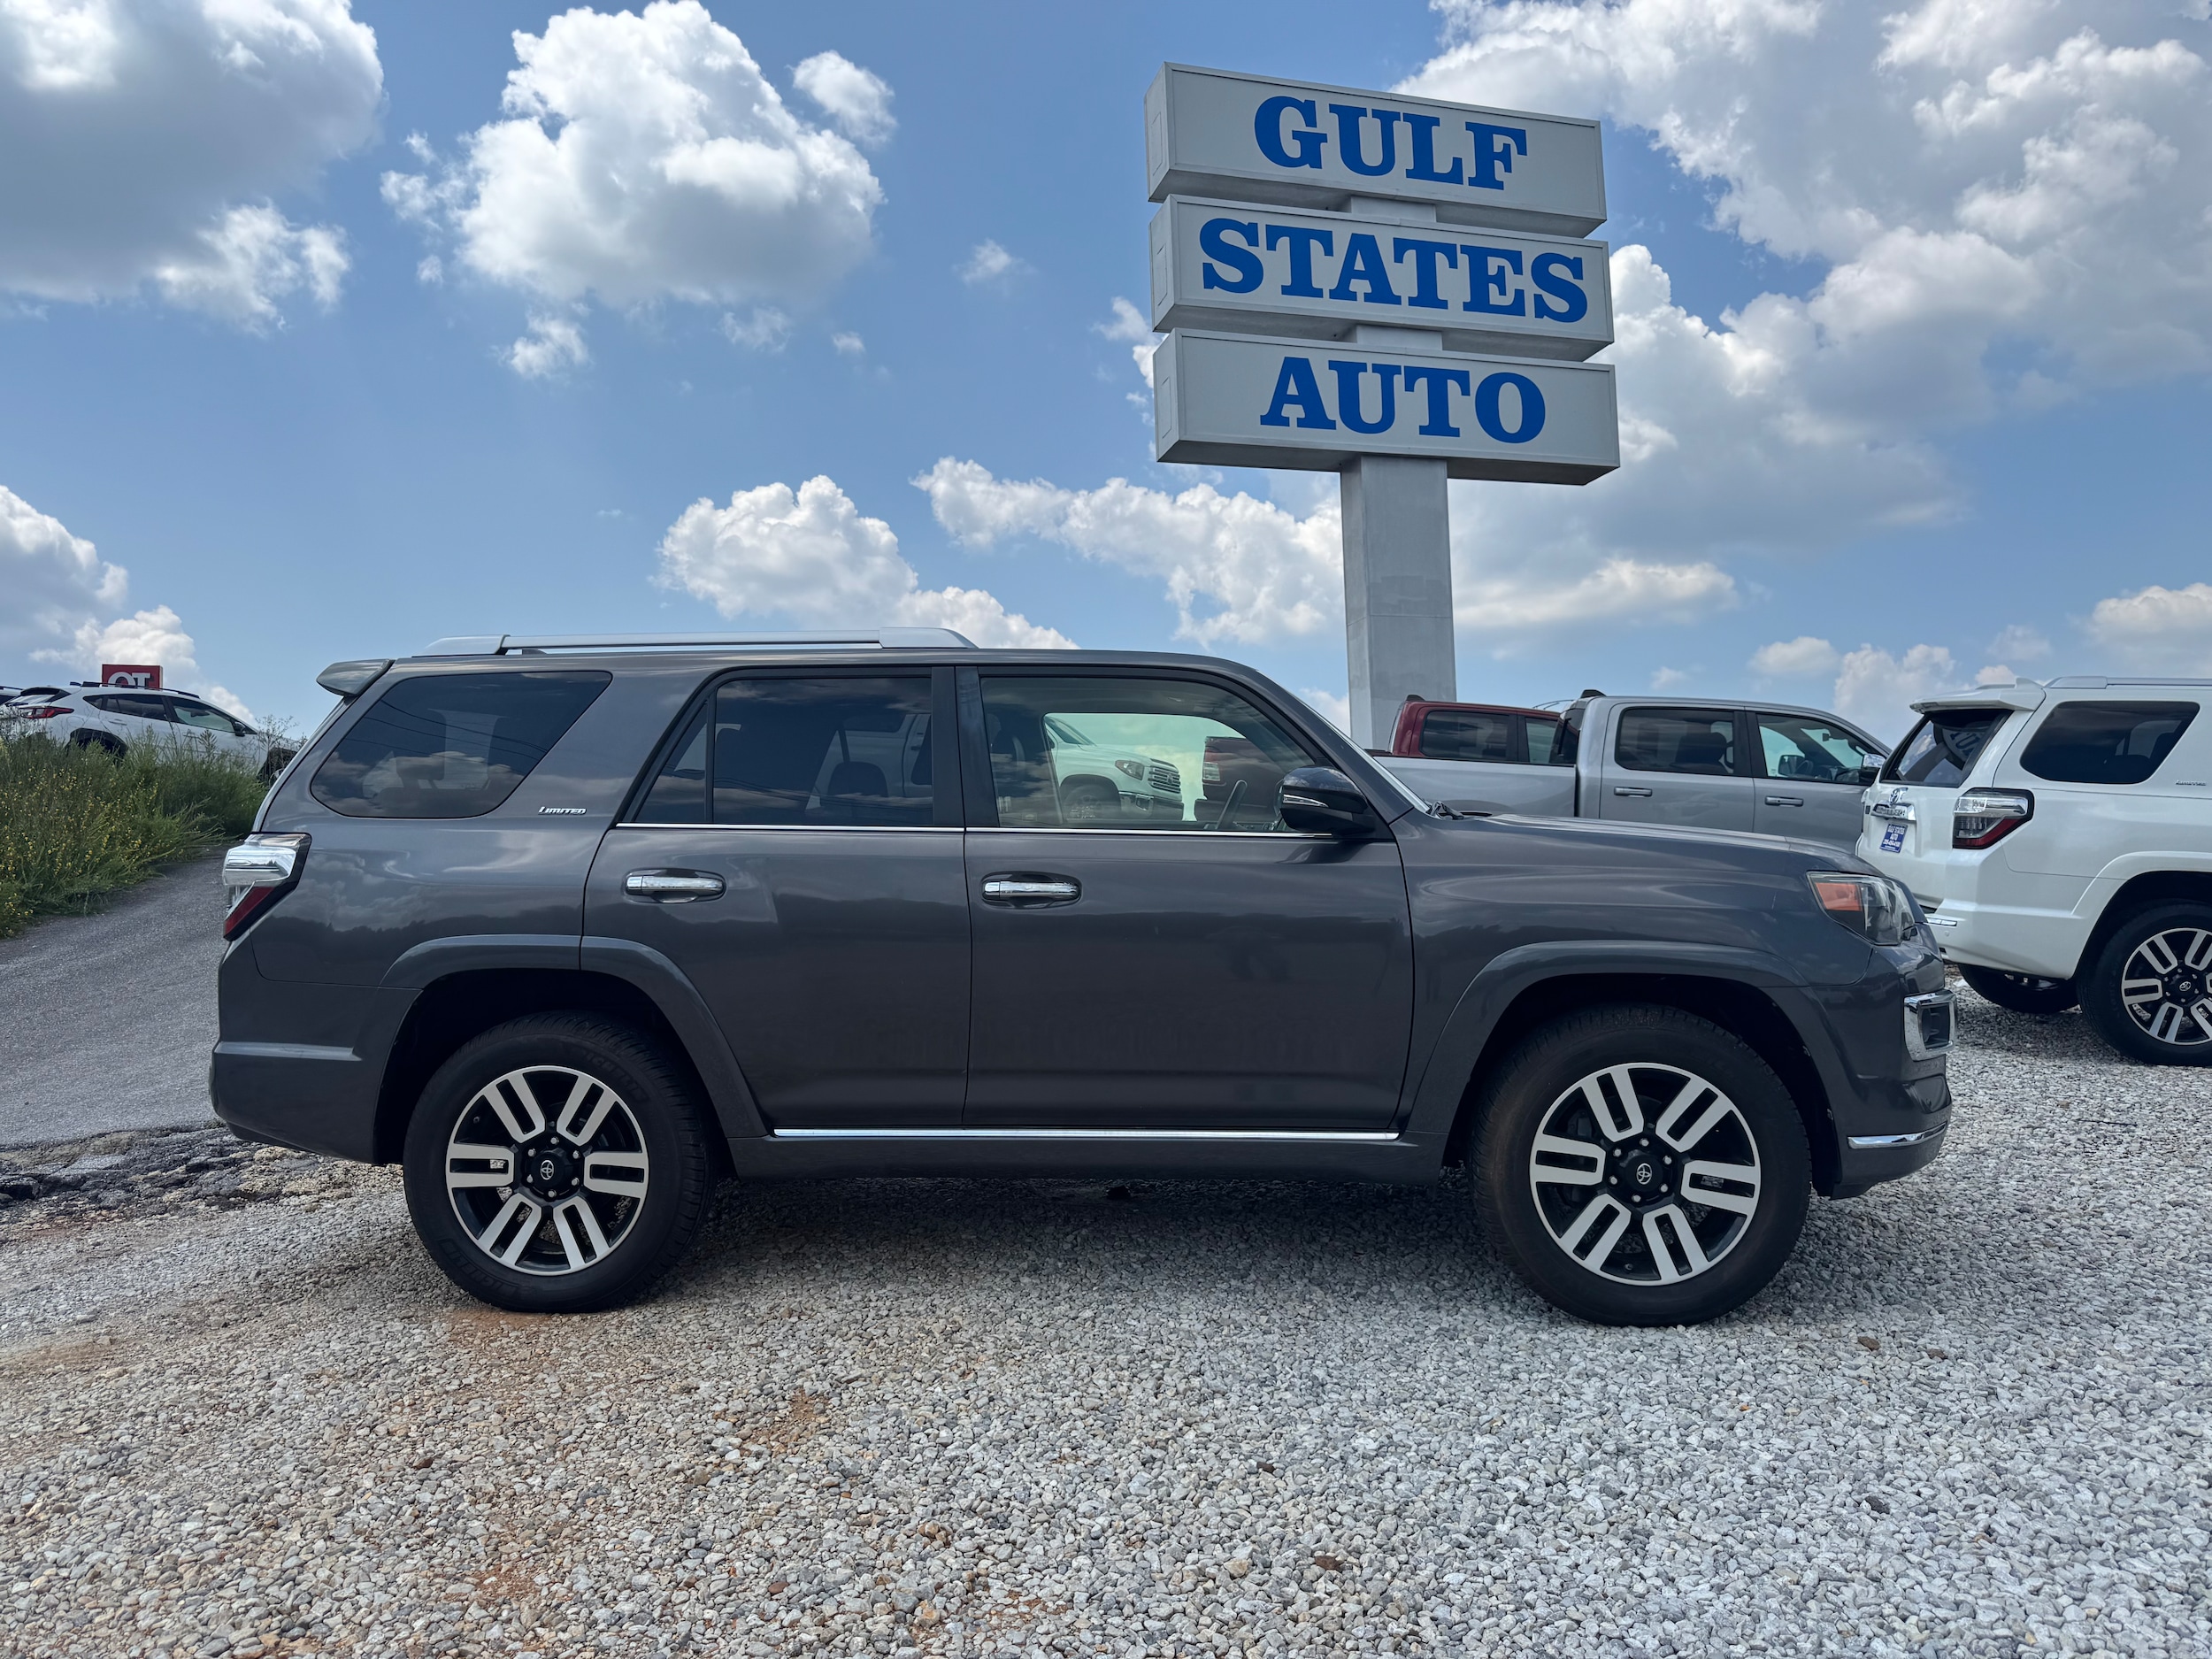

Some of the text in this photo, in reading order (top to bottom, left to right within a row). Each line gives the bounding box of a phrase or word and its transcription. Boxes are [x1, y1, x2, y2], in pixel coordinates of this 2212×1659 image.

[1254, 96, 1527, 190] GULF
[1199, 218, 1588, 323] STATES
[1260, 357, 1546, 444] AUTO
